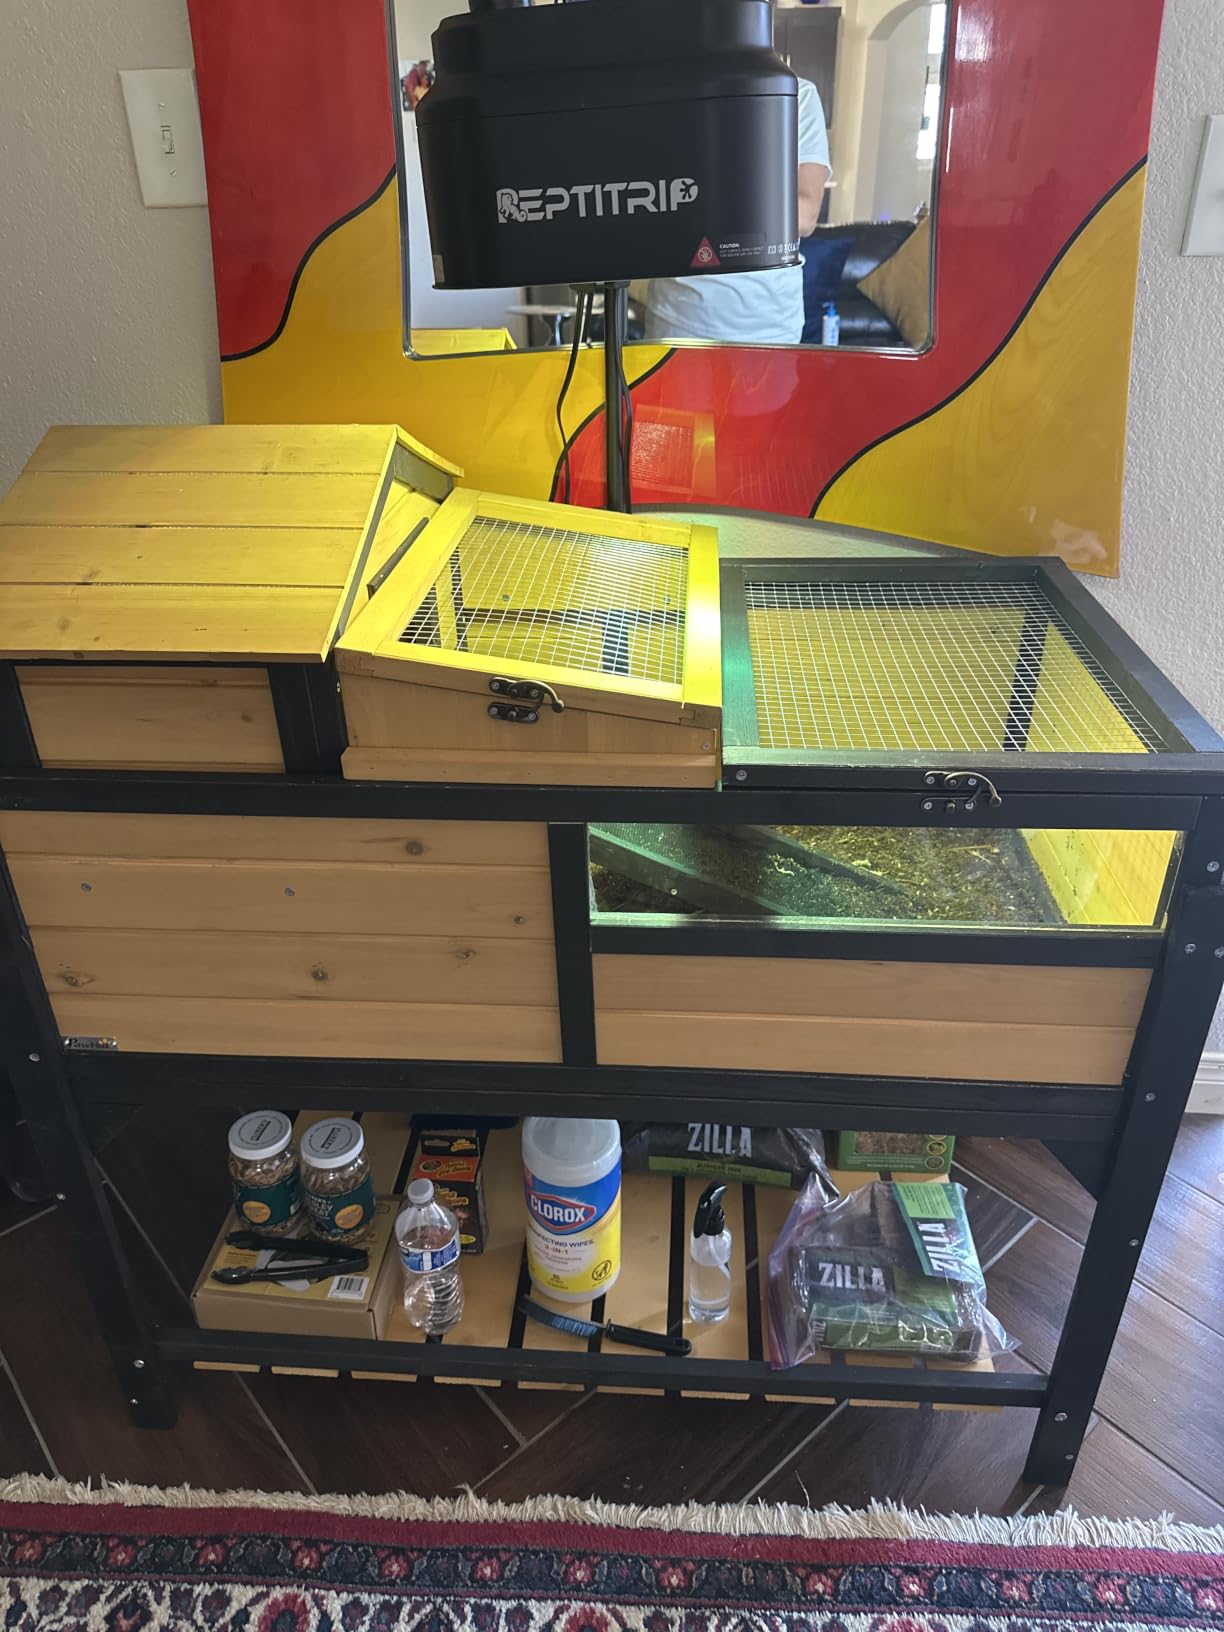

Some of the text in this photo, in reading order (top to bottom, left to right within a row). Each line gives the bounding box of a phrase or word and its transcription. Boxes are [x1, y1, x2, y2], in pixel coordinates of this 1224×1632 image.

[687, 1122, 752, 1158] ZILLA
[530, 1194, 585, 1223] CLOROX
[569, 1238, 595, 1248] WIPES
[917, 1222, 961, 1273] ZILLA
[818, 1262, 887, 1292] ZILLA
